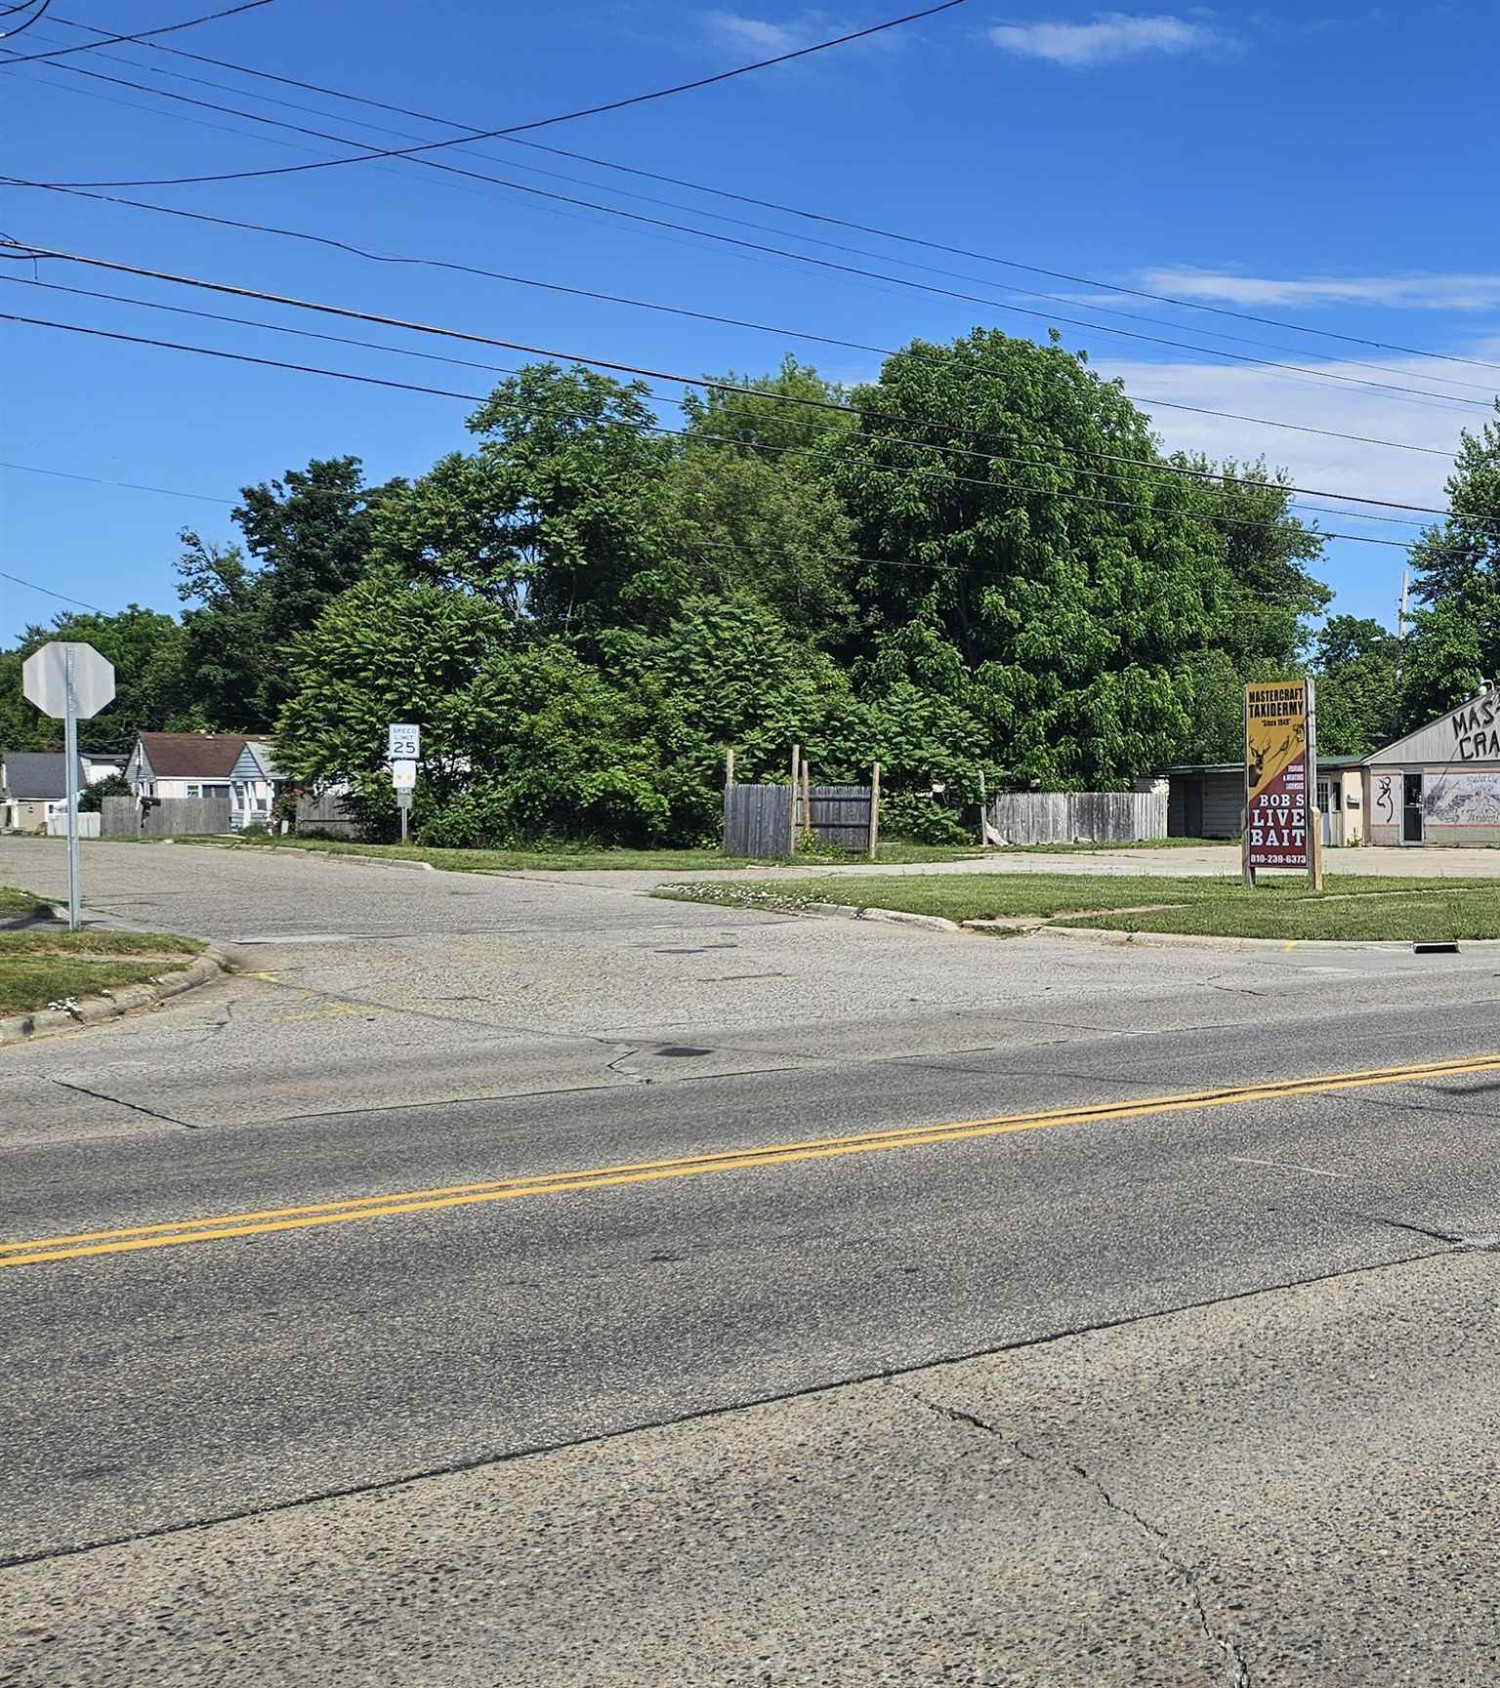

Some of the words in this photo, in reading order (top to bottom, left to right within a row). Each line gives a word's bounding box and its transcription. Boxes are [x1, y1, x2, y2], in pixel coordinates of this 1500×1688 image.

[1249, 687, 1303, 703] MASTERCRAFT
[1249, 701, 1303, 718] TAXIDERMY
[393, 741, 416, 754] 25
[1259, 794, 1305, 806] BOB'S
[1252, 809, 1305, 826] LIVE
[1250, 829, 1305, 846] BAIT
